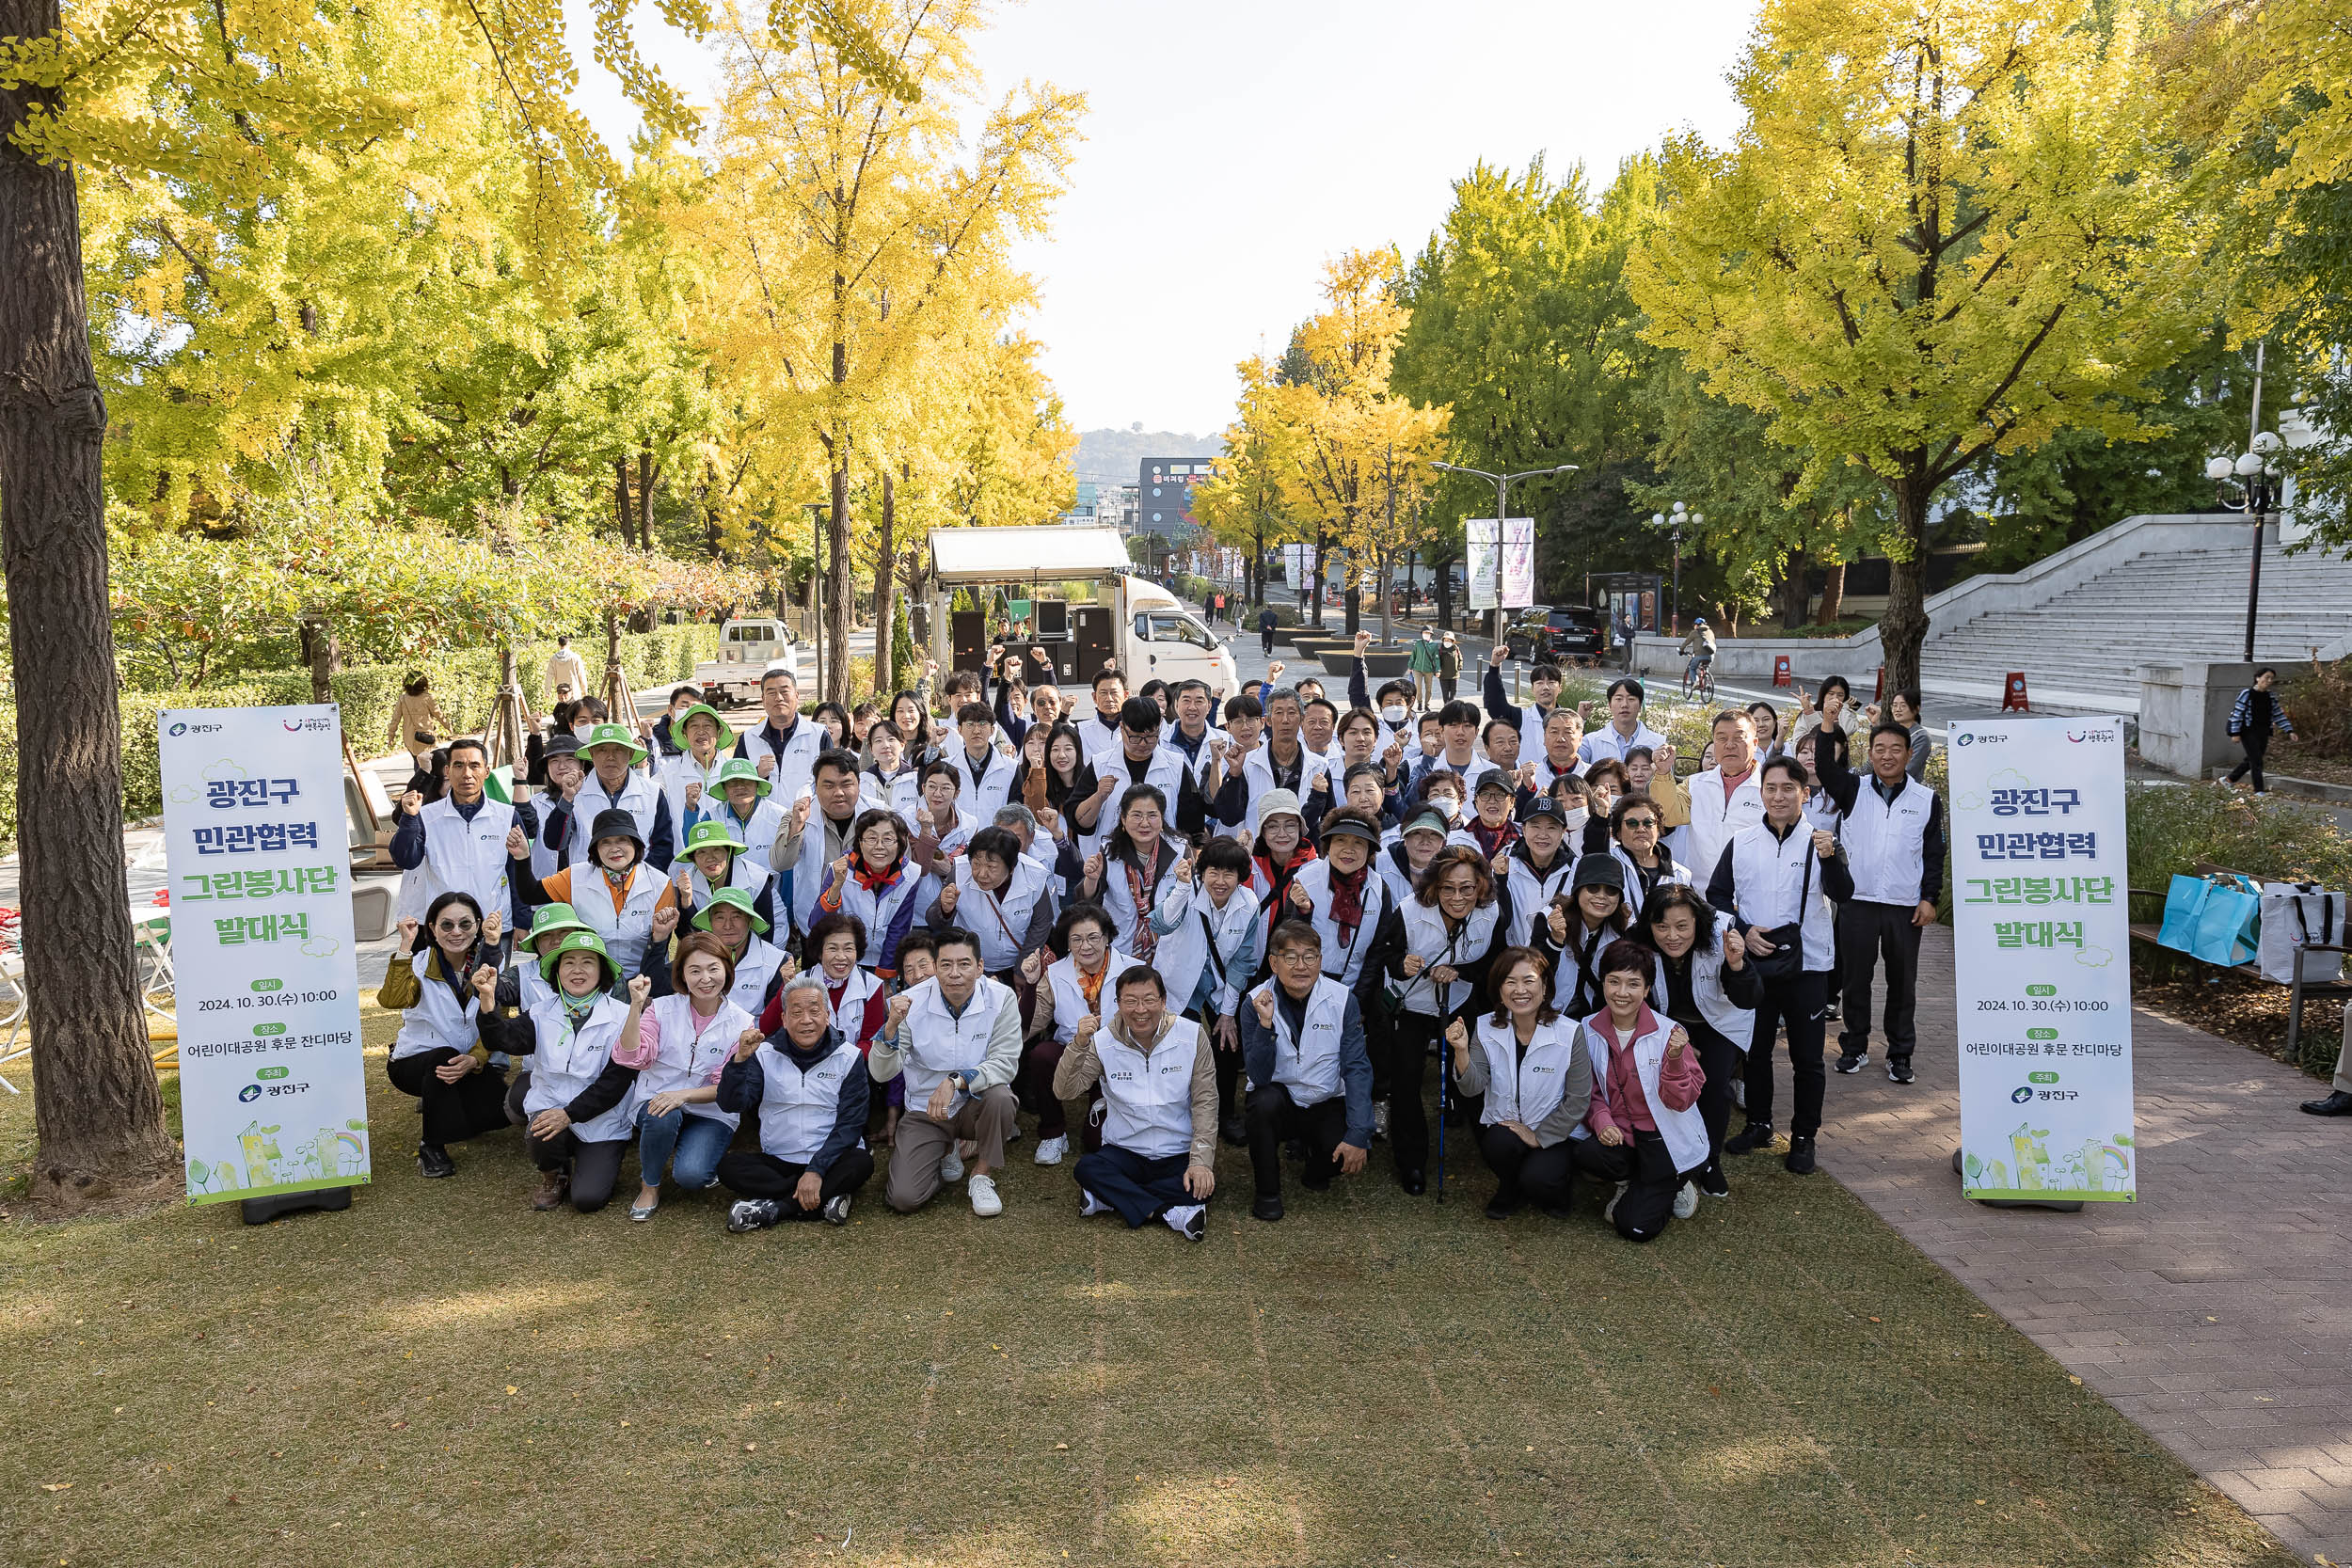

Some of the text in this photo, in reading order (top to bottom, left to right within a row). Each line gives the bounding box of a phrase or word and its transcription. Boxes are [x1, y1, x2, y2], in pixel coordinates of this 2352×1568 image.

[190, 723, 223, 734] 광진구
[1977, 735, 2009, 744] 광진구
[207, 778, 300, 809] 광진구
[1537, 798, 1551, 811] B
[1990, 788, 2081, 816] 광진구
[192, 821, 318, 854] 민관협력
[1977, 832, 2096, 860] 민관협력
[182, 866, 339, 901] 그린봉사단
[1964, 876, 2115, 904] 그린봉사단
[215, 912, 309, 945] 발대식
[1994, 921, 2083, 948] 발대식
[258, 979, 277, 990] 일시
[2032, 986, 2051, 995] 일시
[199, 990, 338, 1012] 2024. 10. 30.(수) 10:00
[1977, 999, 2109, 1013] 2024. 10. 30.(수) 10:00
[261, 1022, 279, 1035] 장소
[2033, 1029, 2052, 1038] 장소
[187, 1030, 354, 1058] 어린이대공원 후문 잔디마당
[1965, 1042, 2123, 1057] 어린이대공원 후문 잔디마당
[263, 1067, 283, 1078] 주최
[2034, 1072, 2053, 1083] 주최
[266, 1083, 311, 1097] 광진구
[2037, 1090, 2080, 1101] 광진구
